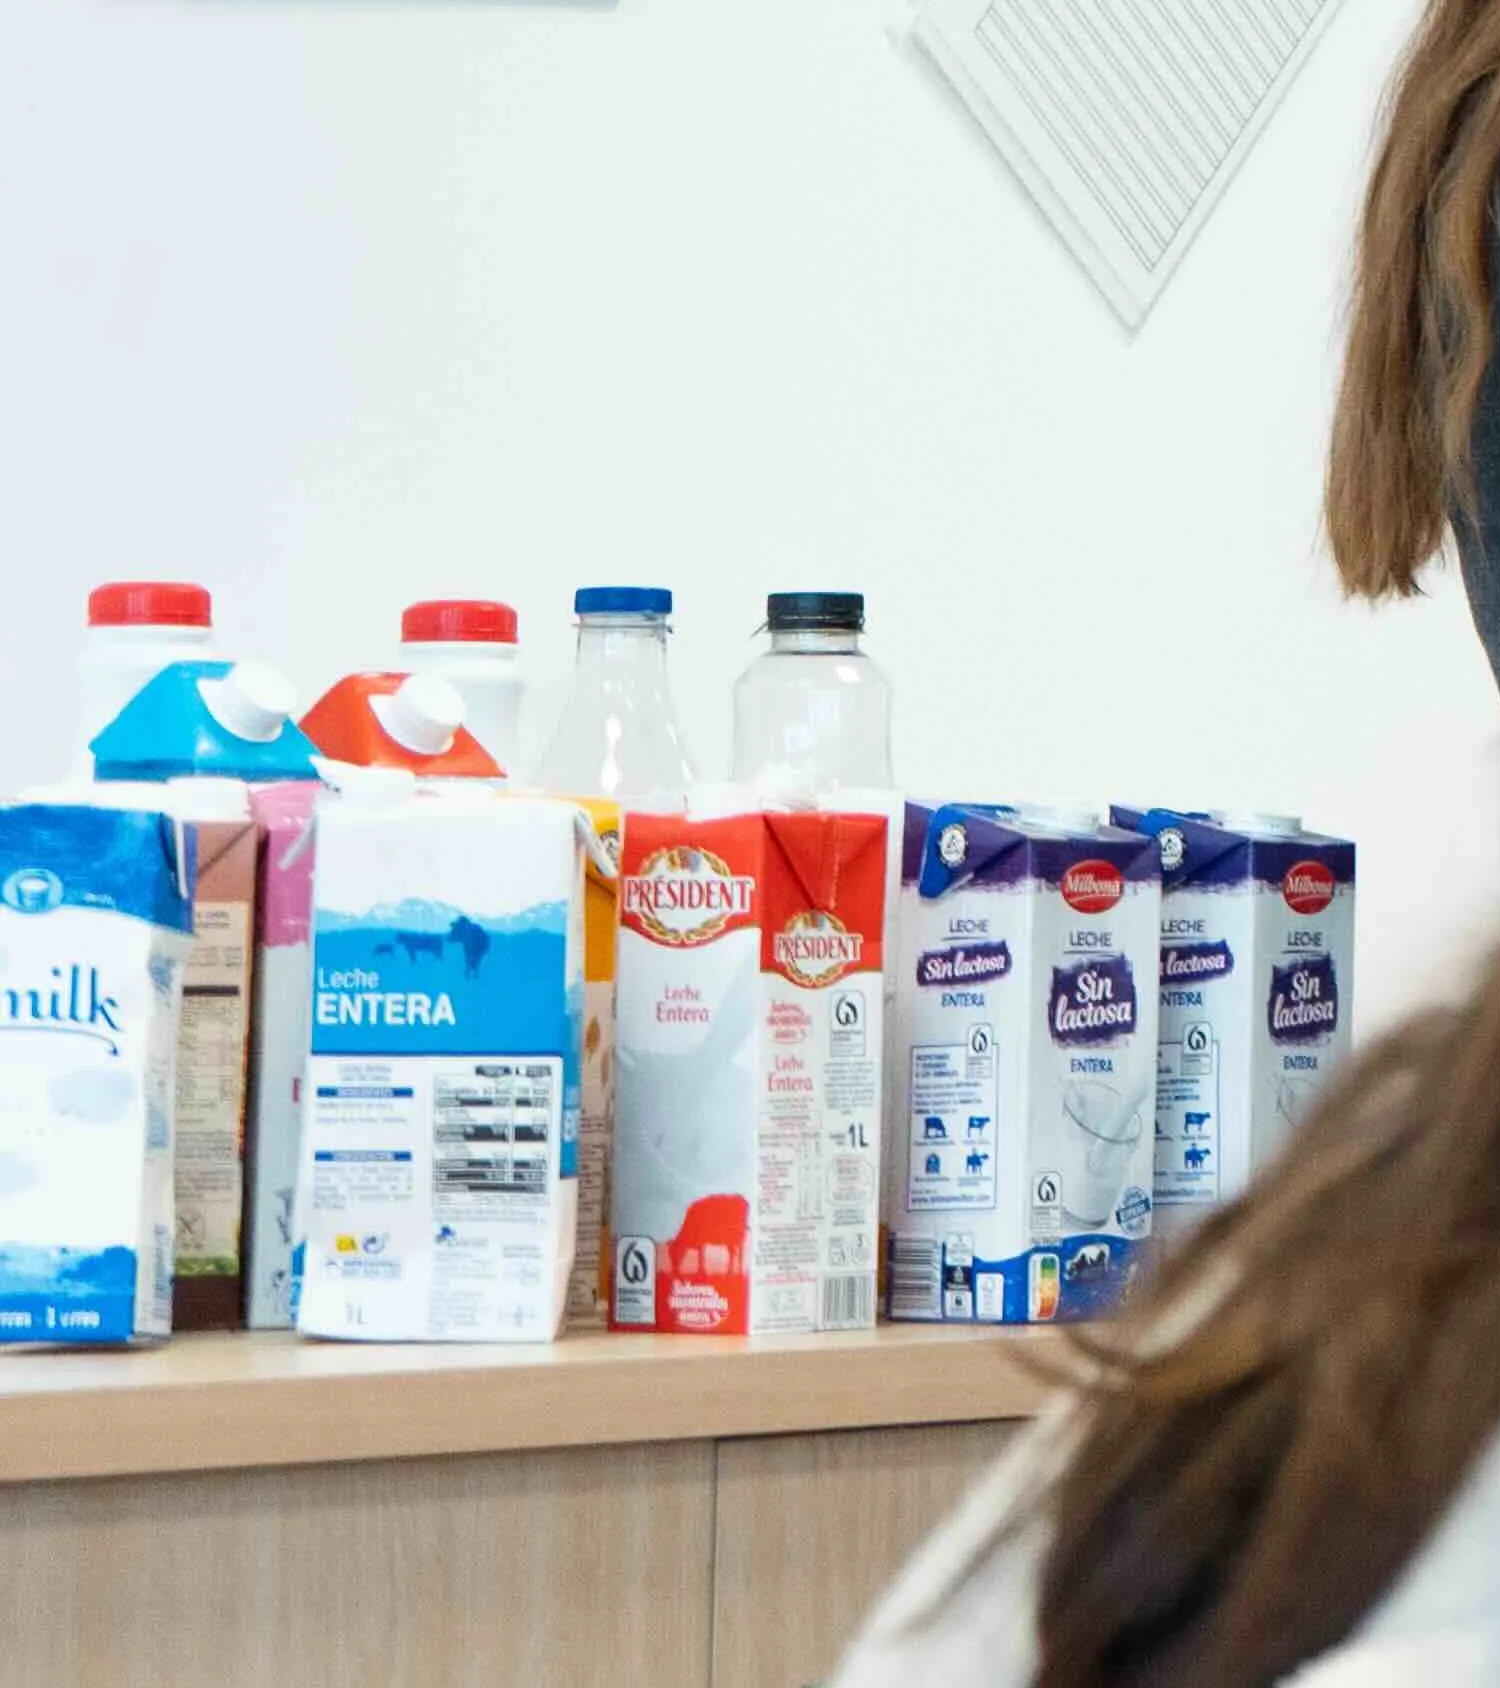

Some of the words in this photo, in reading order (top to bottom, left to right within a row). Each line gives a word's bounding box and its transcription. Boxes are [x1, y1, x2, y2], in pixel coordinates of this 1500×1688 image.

[626, 873, 753, 910] PRÉSIDENT
[949, 919, 988, 933] LECHE
[1161, 919, 1206, 933] LECHE
[776, 933, 861, 961] PRÉSIDENT
[1069, 931, 1112, 947] LECHE
[1287, 931, 1323, 947] LECHE
[925, 958, 952, 981] Sin
[952, 951, 1005, 977] lactosa
[1166, 950, 1226, 976] lactosa
[318, 967, 379, 989] Leche
[1076, 970, 1113, 1004] Sin
[1291, 970, 1321, 1002] Sin
[316, 991, 456, 1027] ENTERA
[941, 992, 985, 1008] ENTERA
[1161, 991, 1203, 1006] NTERA
[1055, 994, 1132, 1032] lactosa
[1274, 993, 1334, 1029] lactosa
[1070, 1057, 1113, 1073] ENTERA
[1283, 1055, 1319, 1070] ENTERA
